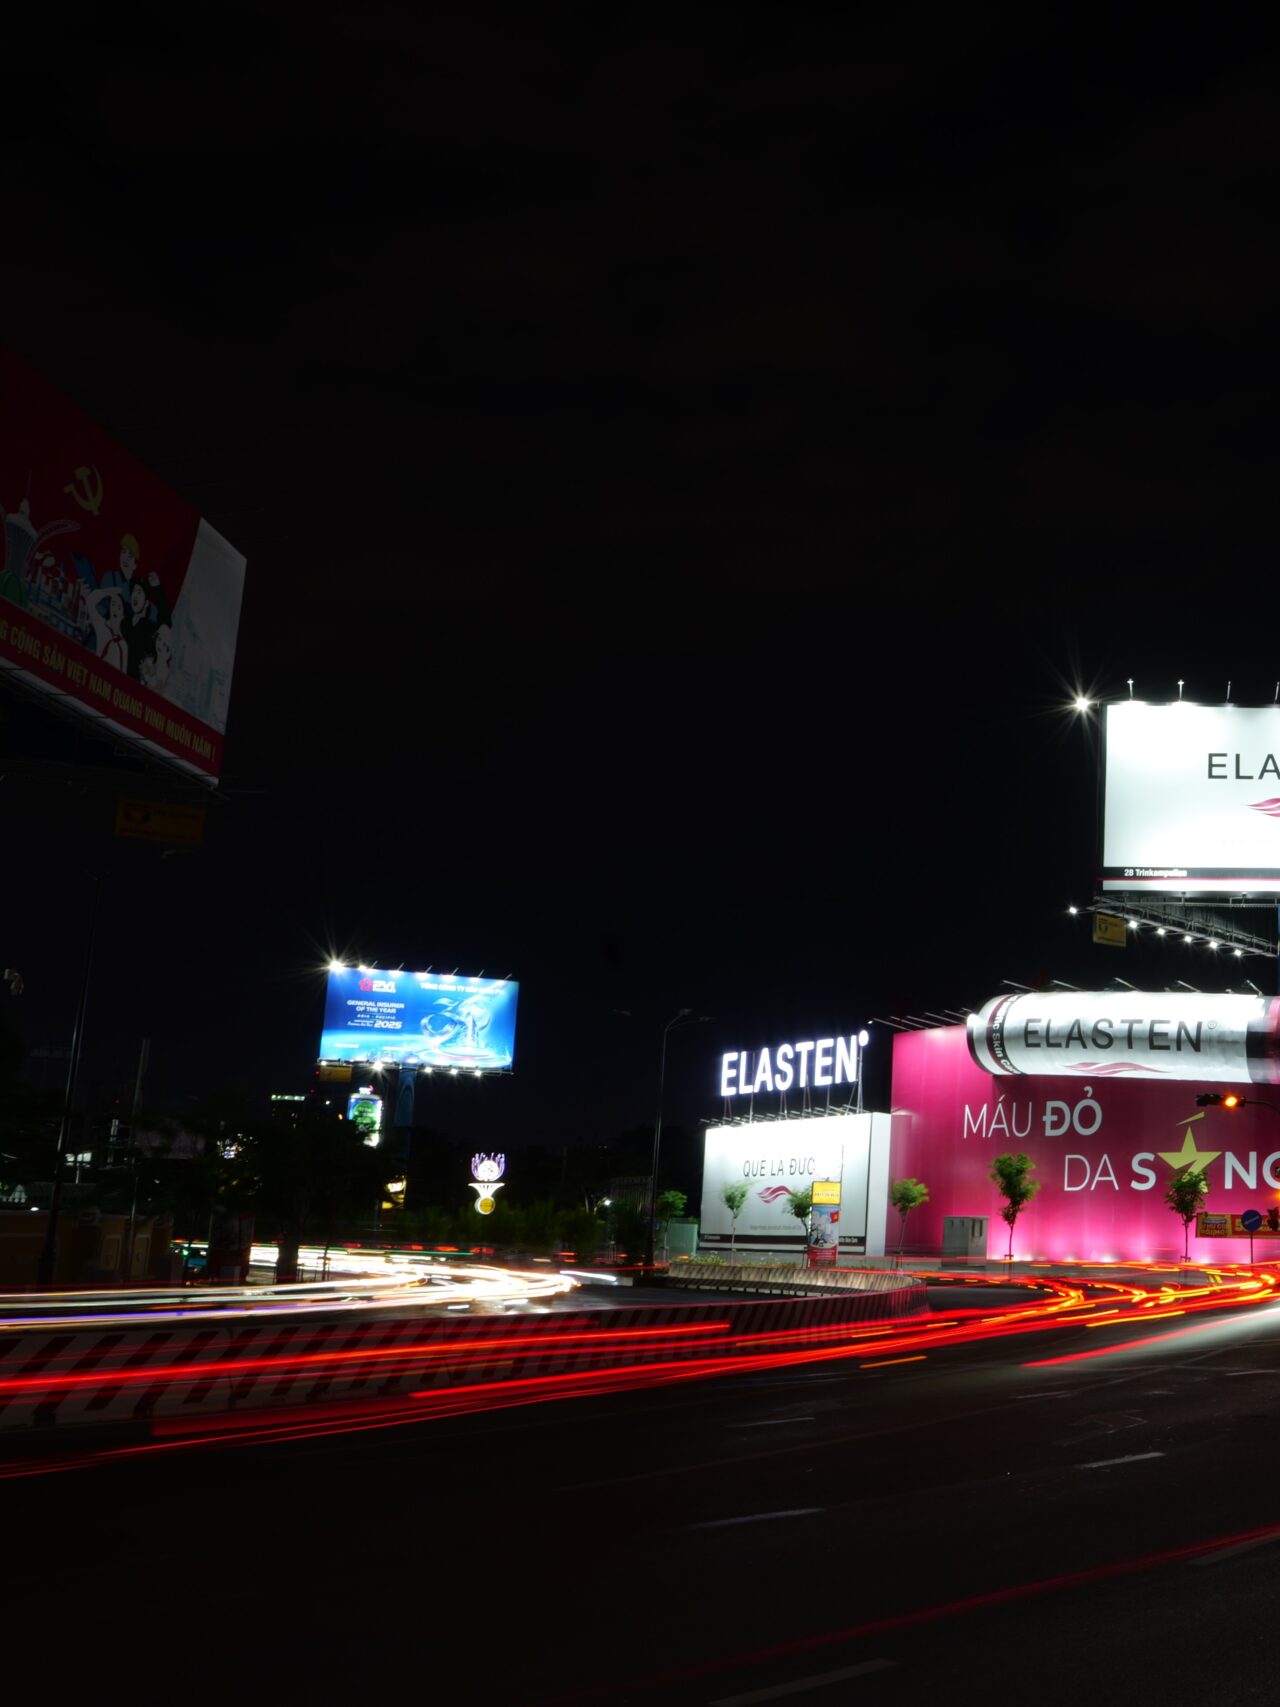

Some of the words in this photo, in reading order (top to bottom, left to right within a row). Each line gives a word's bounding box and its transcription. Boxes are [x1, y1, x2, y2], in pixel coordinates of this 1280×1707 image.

[10, 625, 41, 659] CỘNG
[42, 643, 66, 673] SẢN
[66, 657, 88, 687] VIỆT
[88, 672, 112, 702] NAM
[112, 687, 143, 719] QUANG
[143, 704, 167, 733] VINH
[1124, 869, 1134, 877] 28
[374, 1020, 403, 1029] 2025
[963, 1095, 1032, 1139] MÁU
[1042, 1086, 1103, 1137] ĐỎ
[1063, 1153, 1120, 1192] DA
